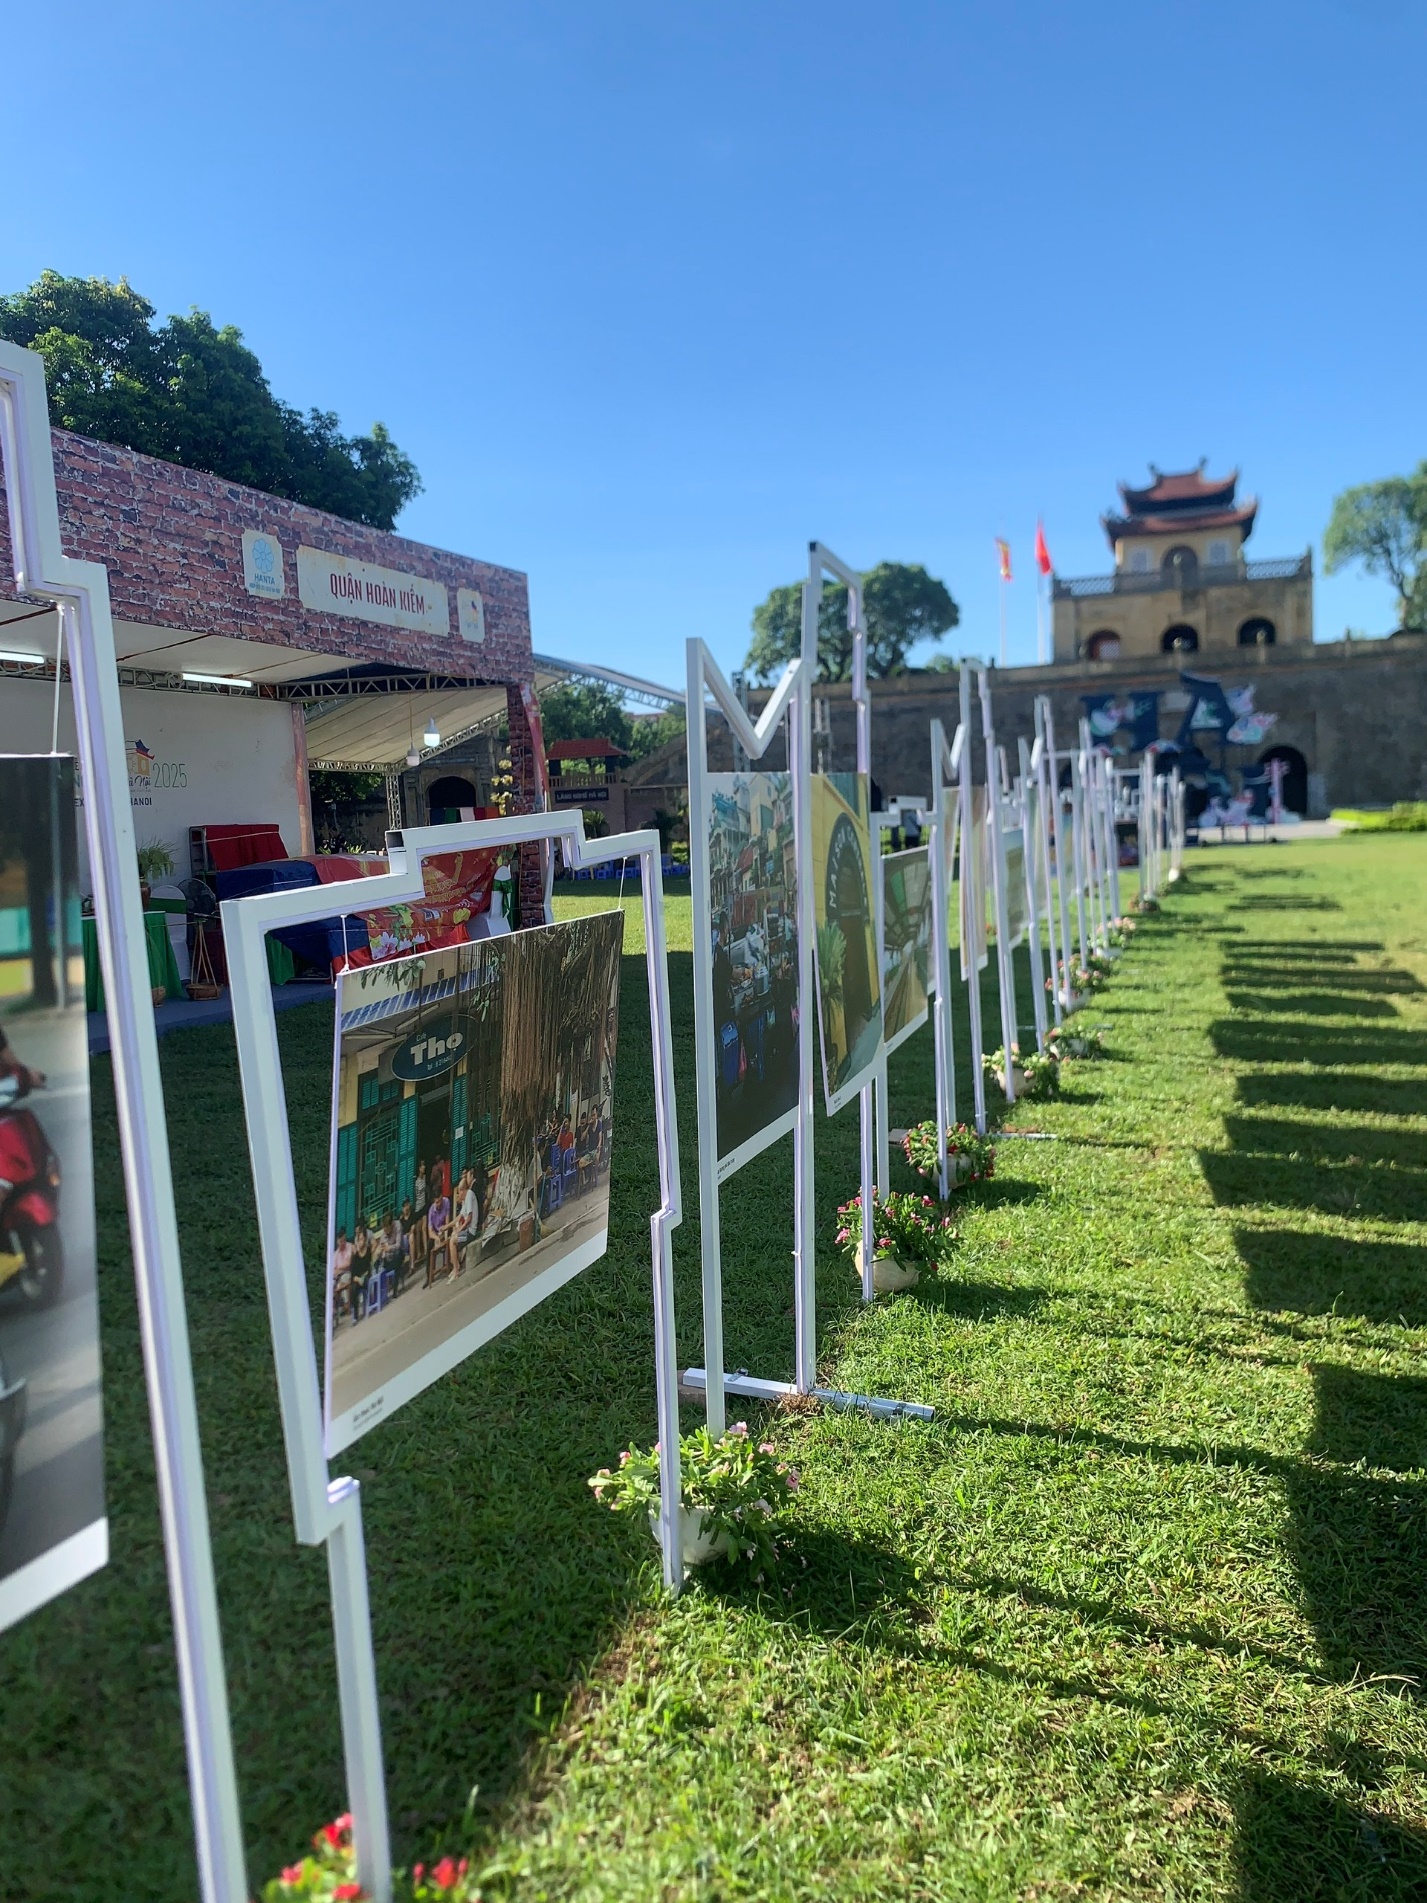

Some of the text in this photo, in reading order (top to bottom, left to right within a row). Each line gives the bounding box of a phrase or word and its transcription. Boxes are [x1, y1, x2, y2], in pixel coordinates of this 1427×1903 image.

[254, 572, 276, 586] HANTA
[330, 572, 425, 615] QUẬN HOÀN KIẾM
[152, 762, 188, 789] 2025
[410, 1032, 463, 1065] Thọ
